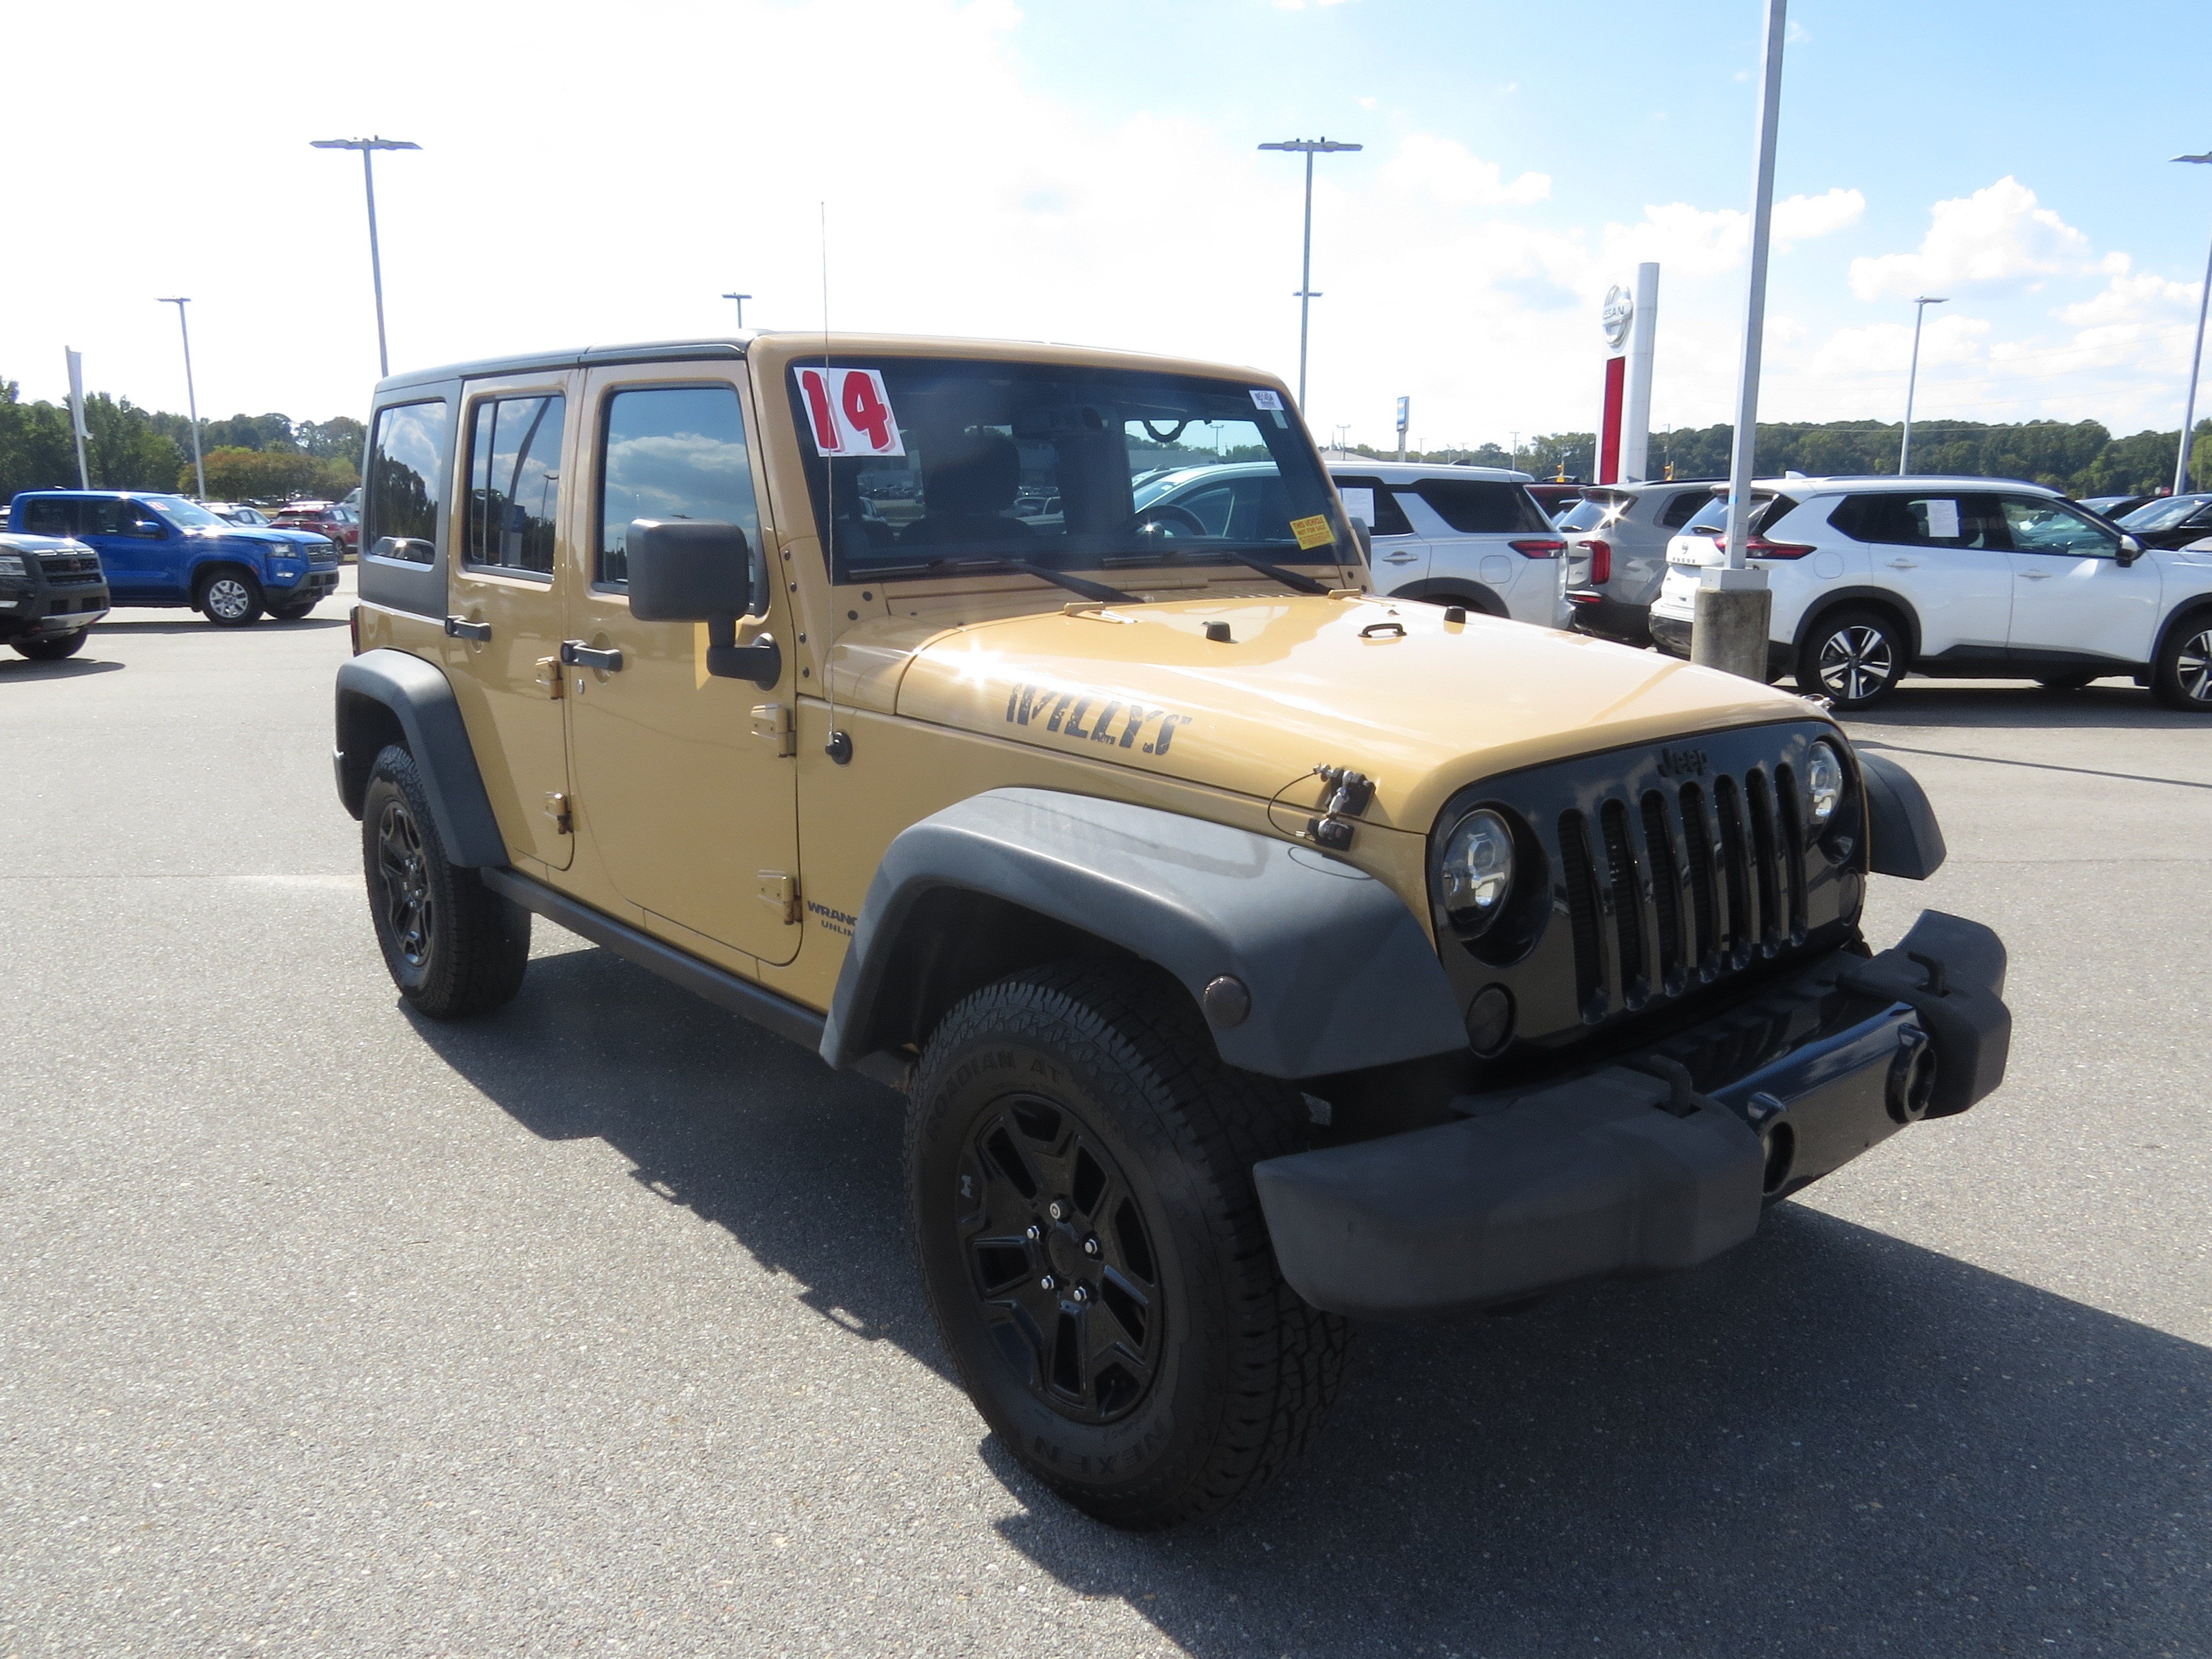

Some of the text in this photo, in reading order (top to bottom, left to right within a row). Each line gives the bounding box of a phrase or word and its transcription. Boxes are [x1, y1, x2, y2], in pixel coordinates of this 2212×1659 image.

[802, 371, 890, 451] 14
[1006, 682, 1180, 755] WILLYS
[1657, 748, 1707, 778] Jeep
